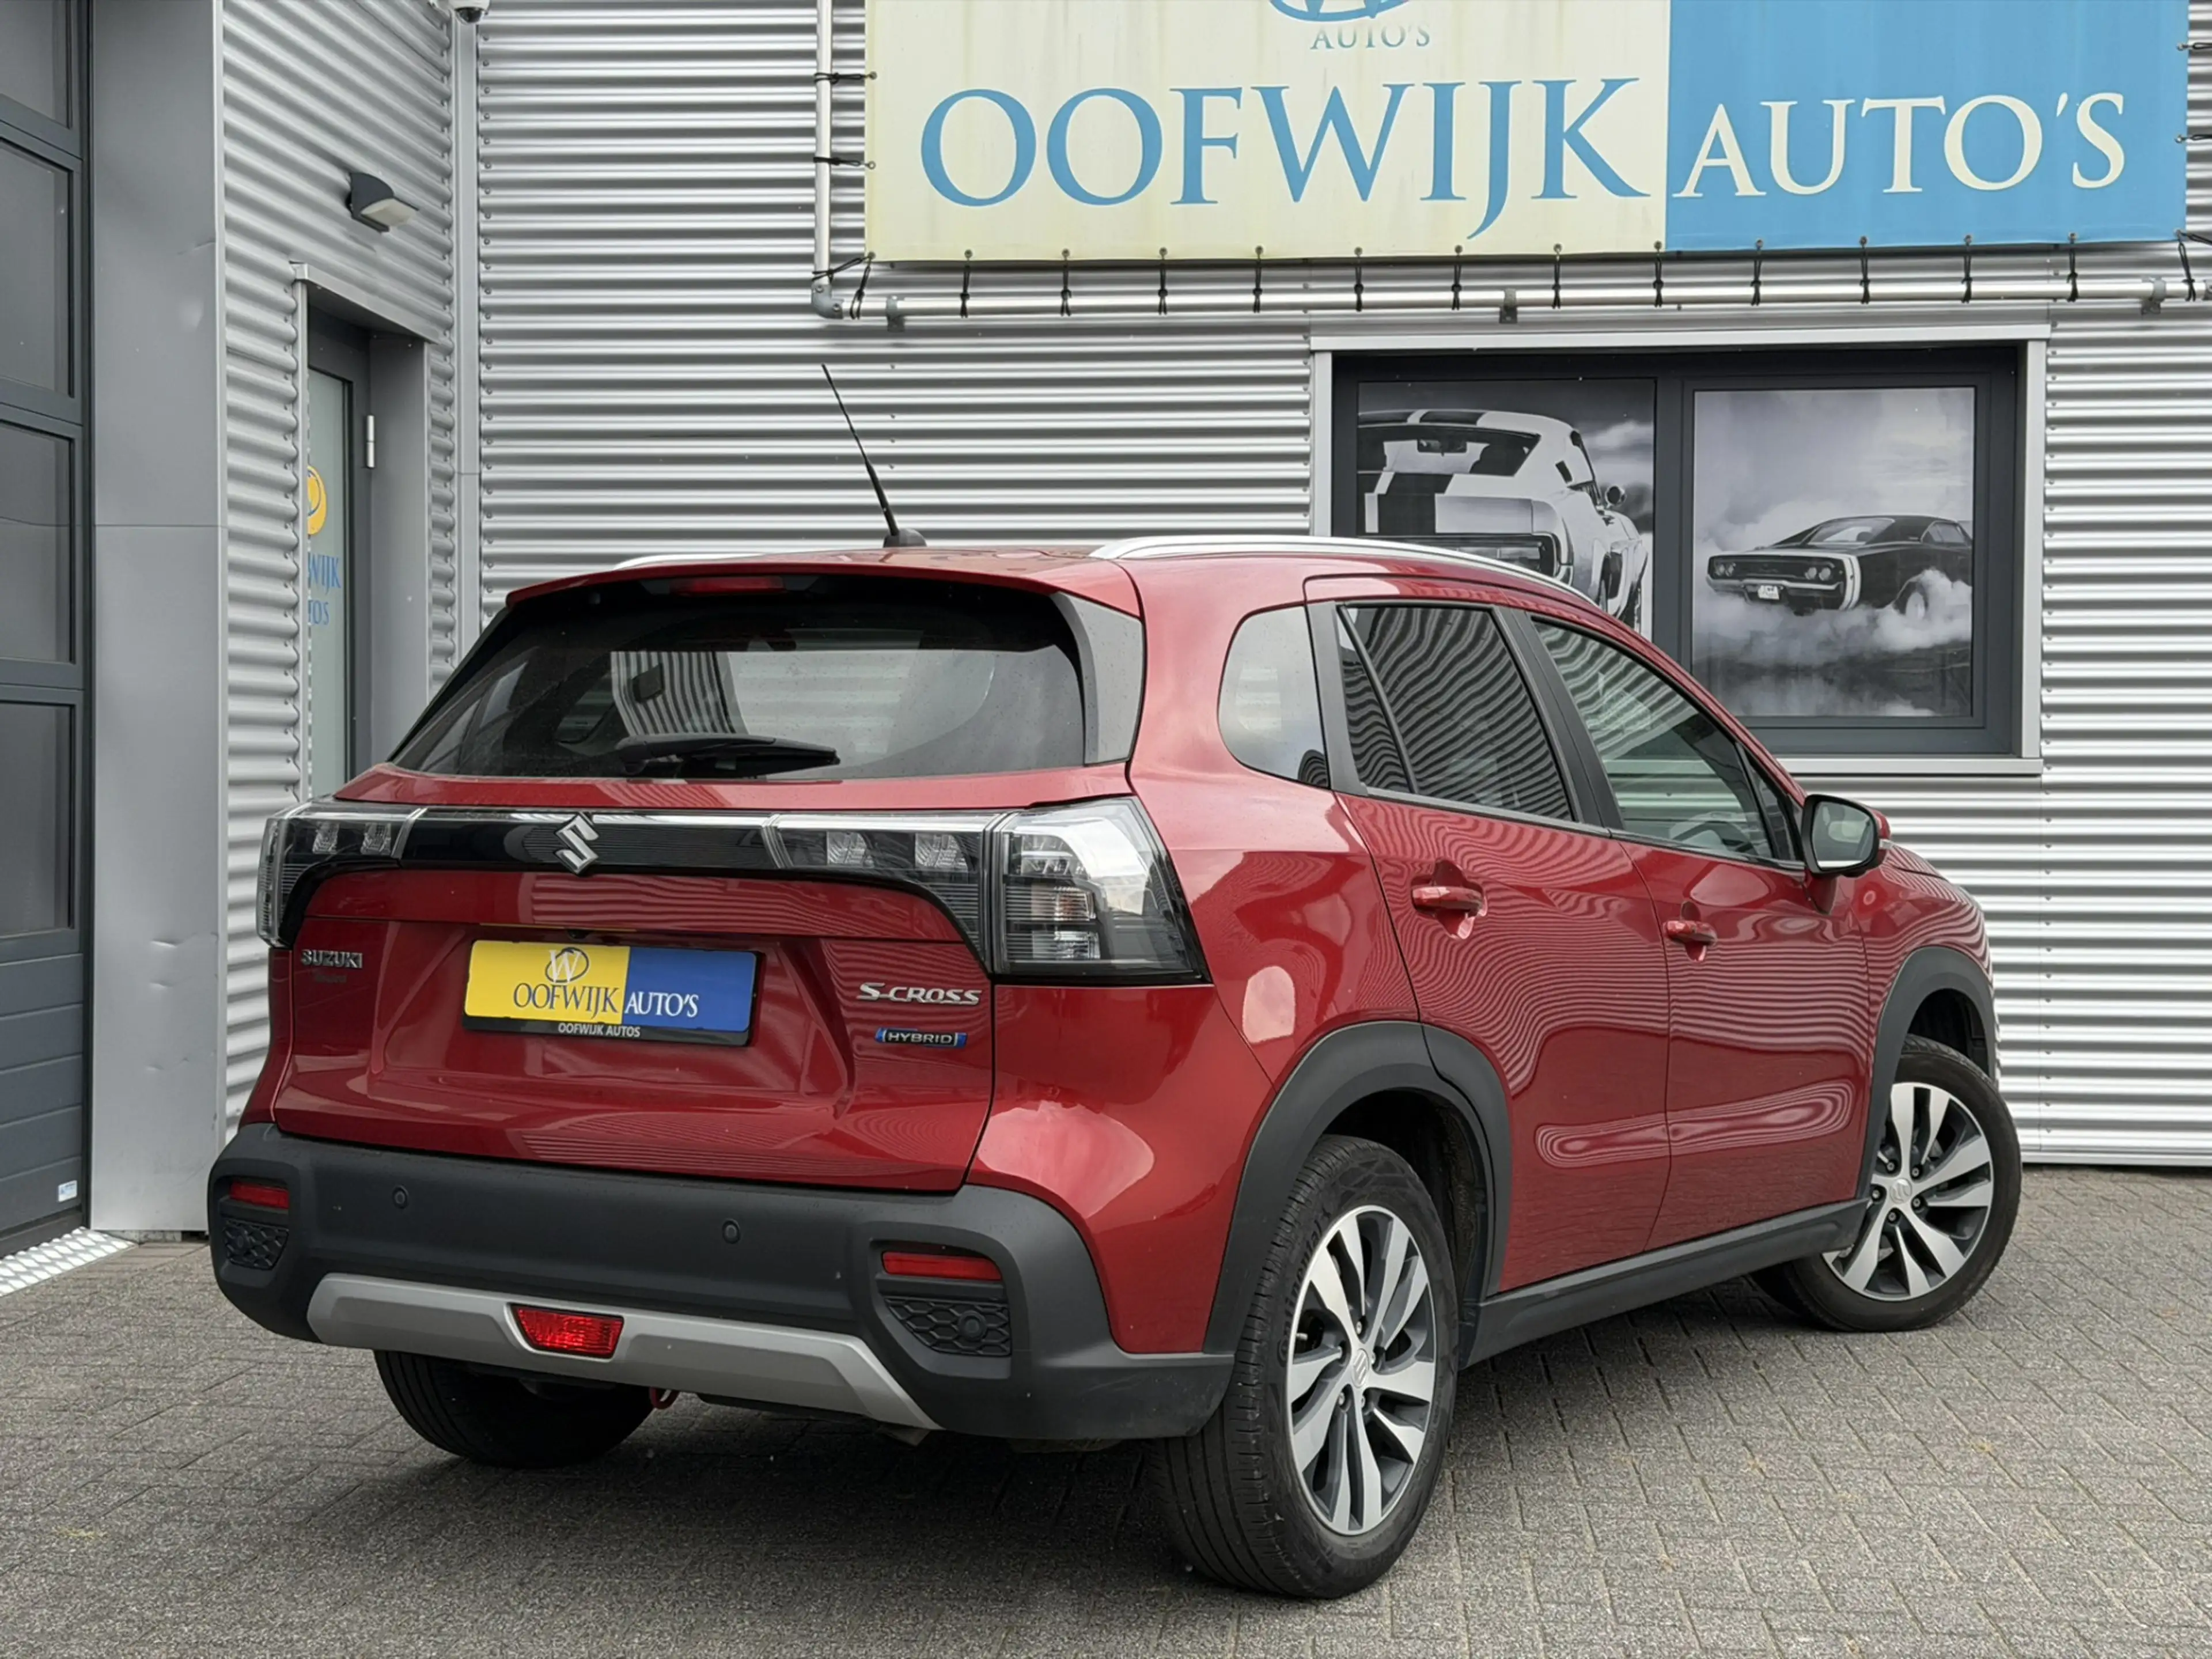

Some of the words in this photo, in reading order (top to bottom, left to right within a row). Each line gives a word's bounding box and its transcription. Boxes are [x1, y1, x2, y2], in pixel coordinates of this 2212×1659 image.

[920, 77, 1651, 240] OOFWIJK
[1672, 92, 2126, 198] AUTO'S
[301, 949, 363, 969] SUZUKI
[513, 982, 620, 1019] OOFWIJK
[624, 991, 699, 1017] AUTO'S
[856, 982, 982, 1005] S-CROSS
[558, 1022, 604, 1035] OOFWIJK
[605, 1025, 641, 1037] AUTOS
[888, 1032, 952, 1044] HYBRID
